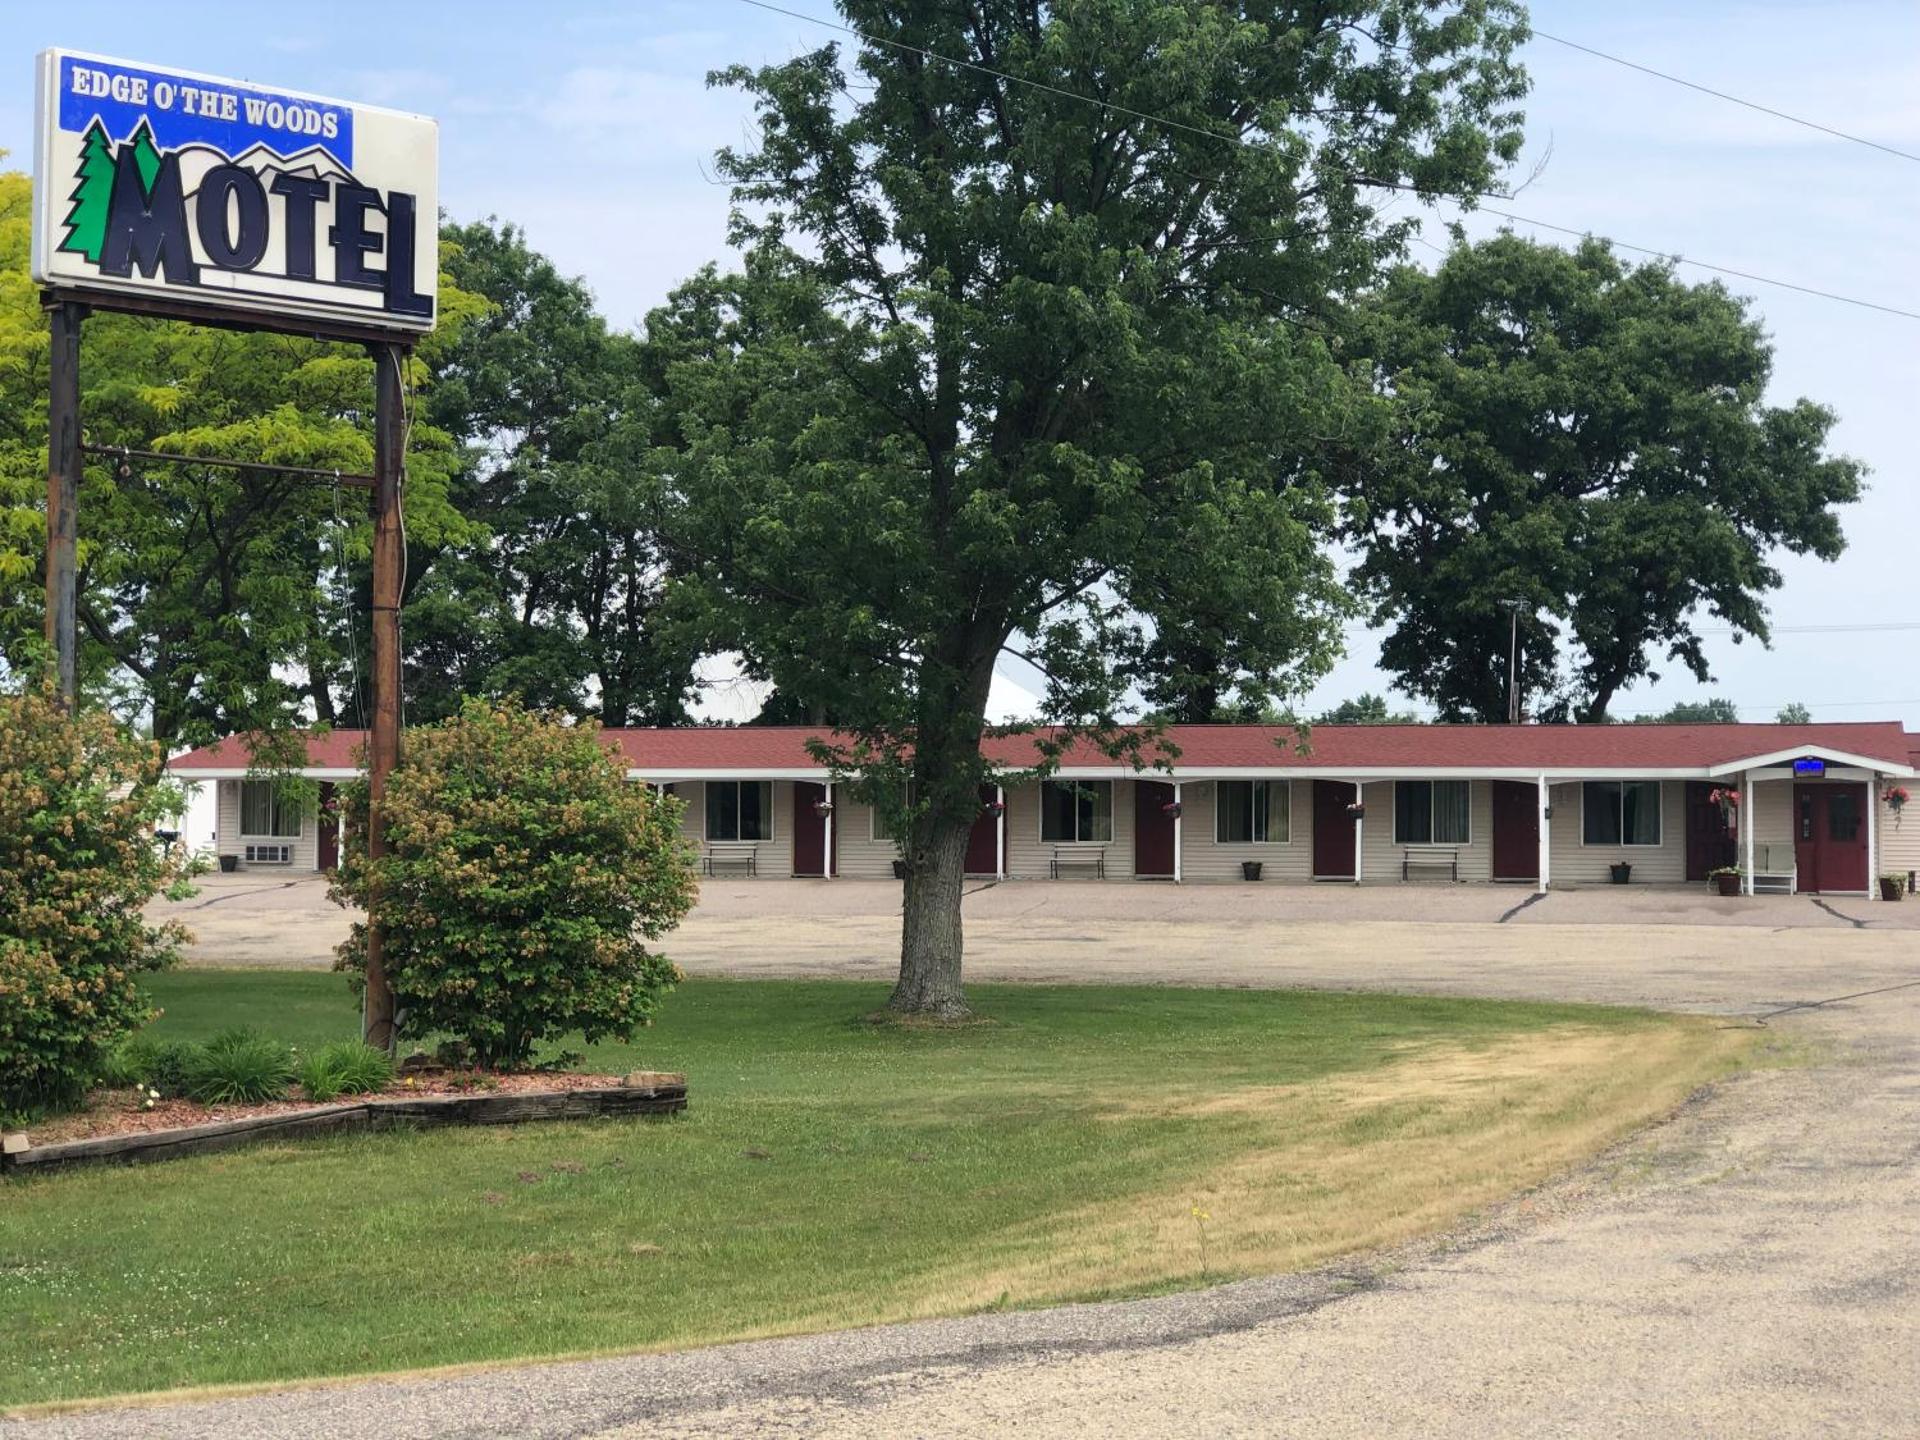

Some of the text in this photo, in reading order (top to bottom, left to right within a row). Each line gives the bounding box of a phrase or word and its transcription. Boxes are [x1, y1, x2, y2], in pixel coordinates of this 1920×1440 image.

[72, 65, 148, 106] EDGE
[244, 97, 339, 139] WOODS
[100, 143, 433, 318] MOTEL
